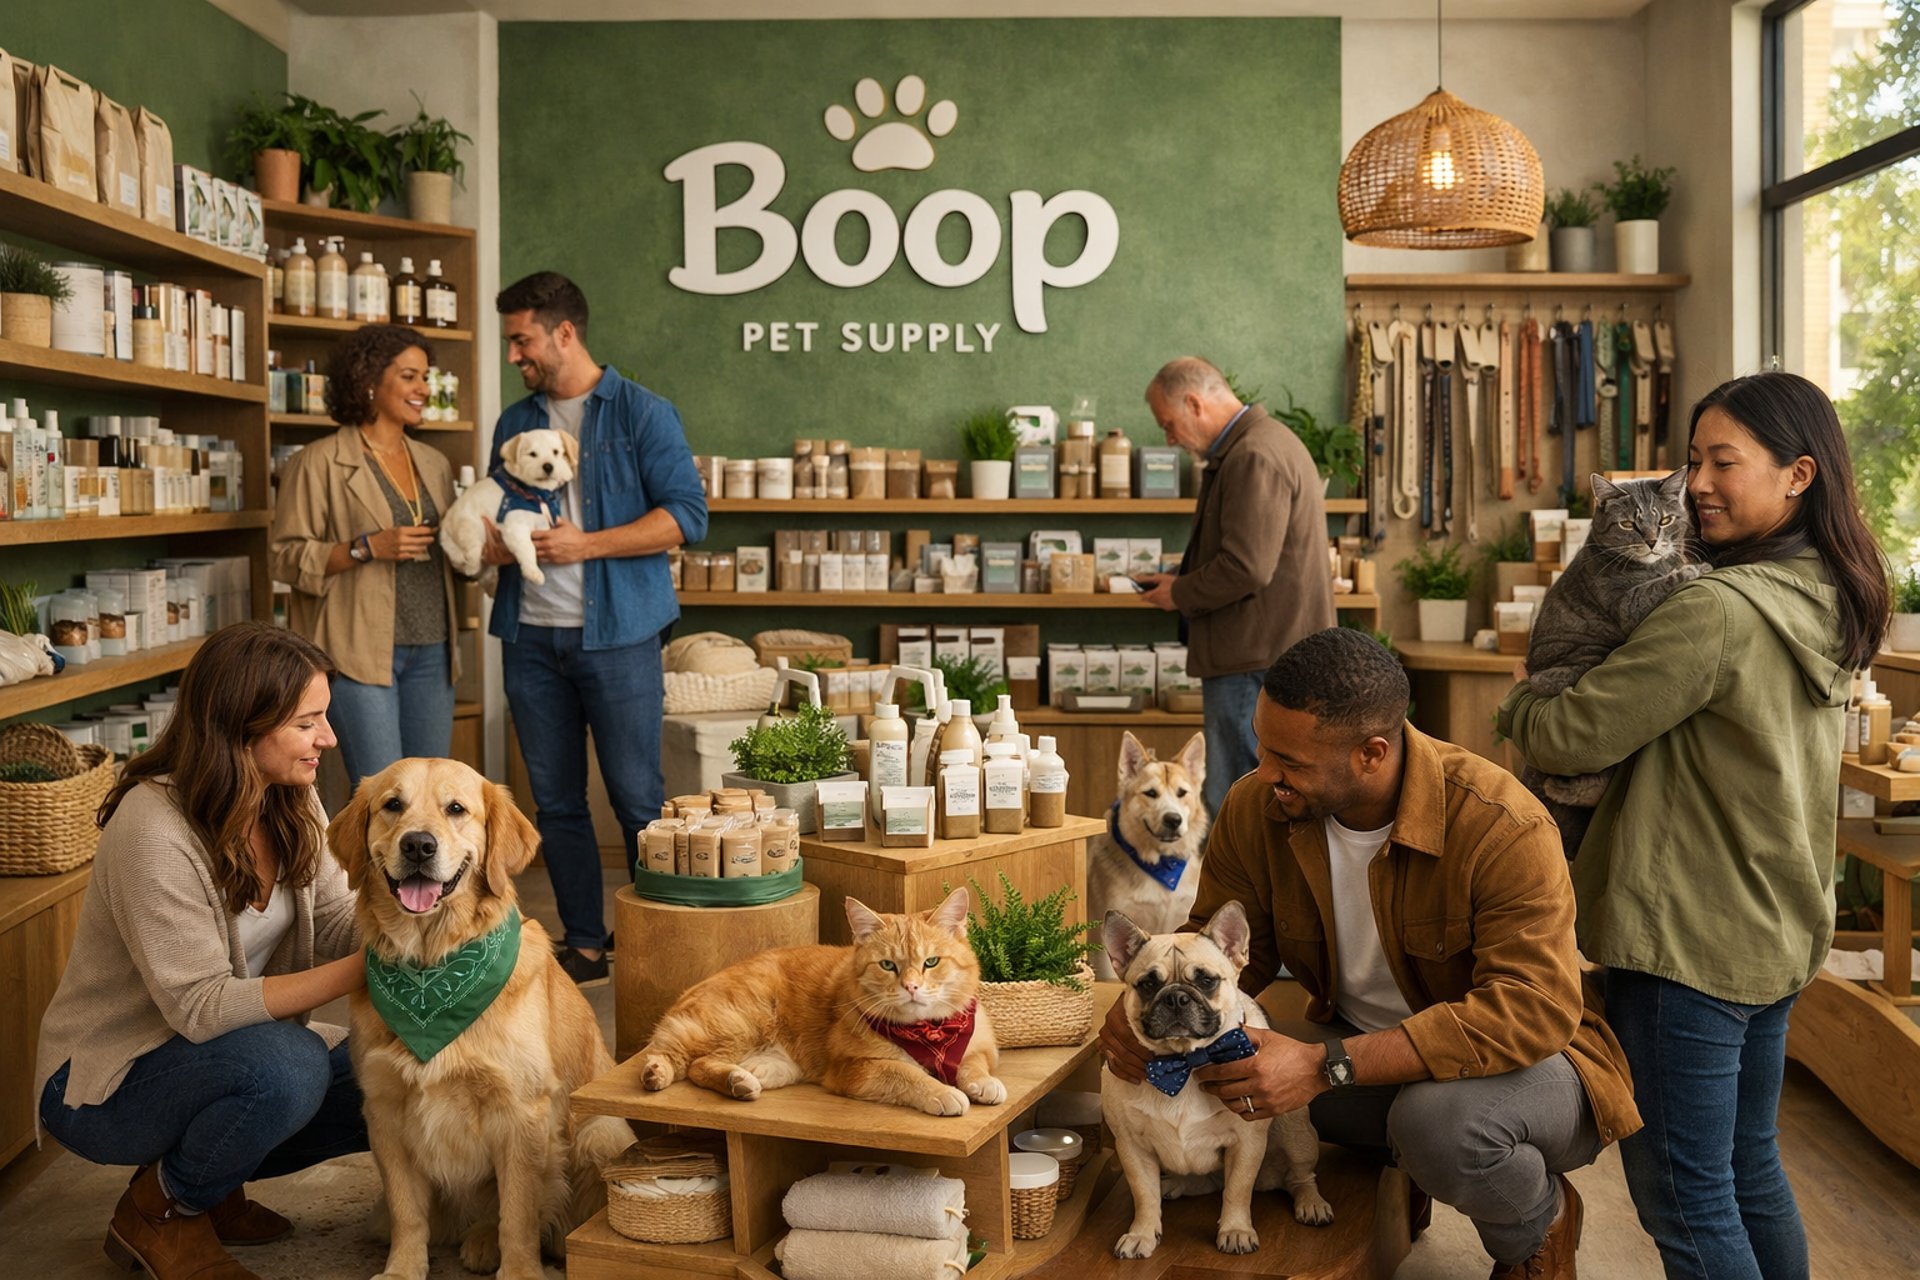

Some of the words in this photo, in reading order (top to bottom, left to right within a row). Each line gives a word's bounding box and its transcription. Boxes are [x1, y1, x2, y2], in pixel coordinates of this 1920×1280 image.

[664, 141, 1120, 333] Boop
[743, 322, 819, 352] PET
[842, 322, 1001, 352] SUPPLY
